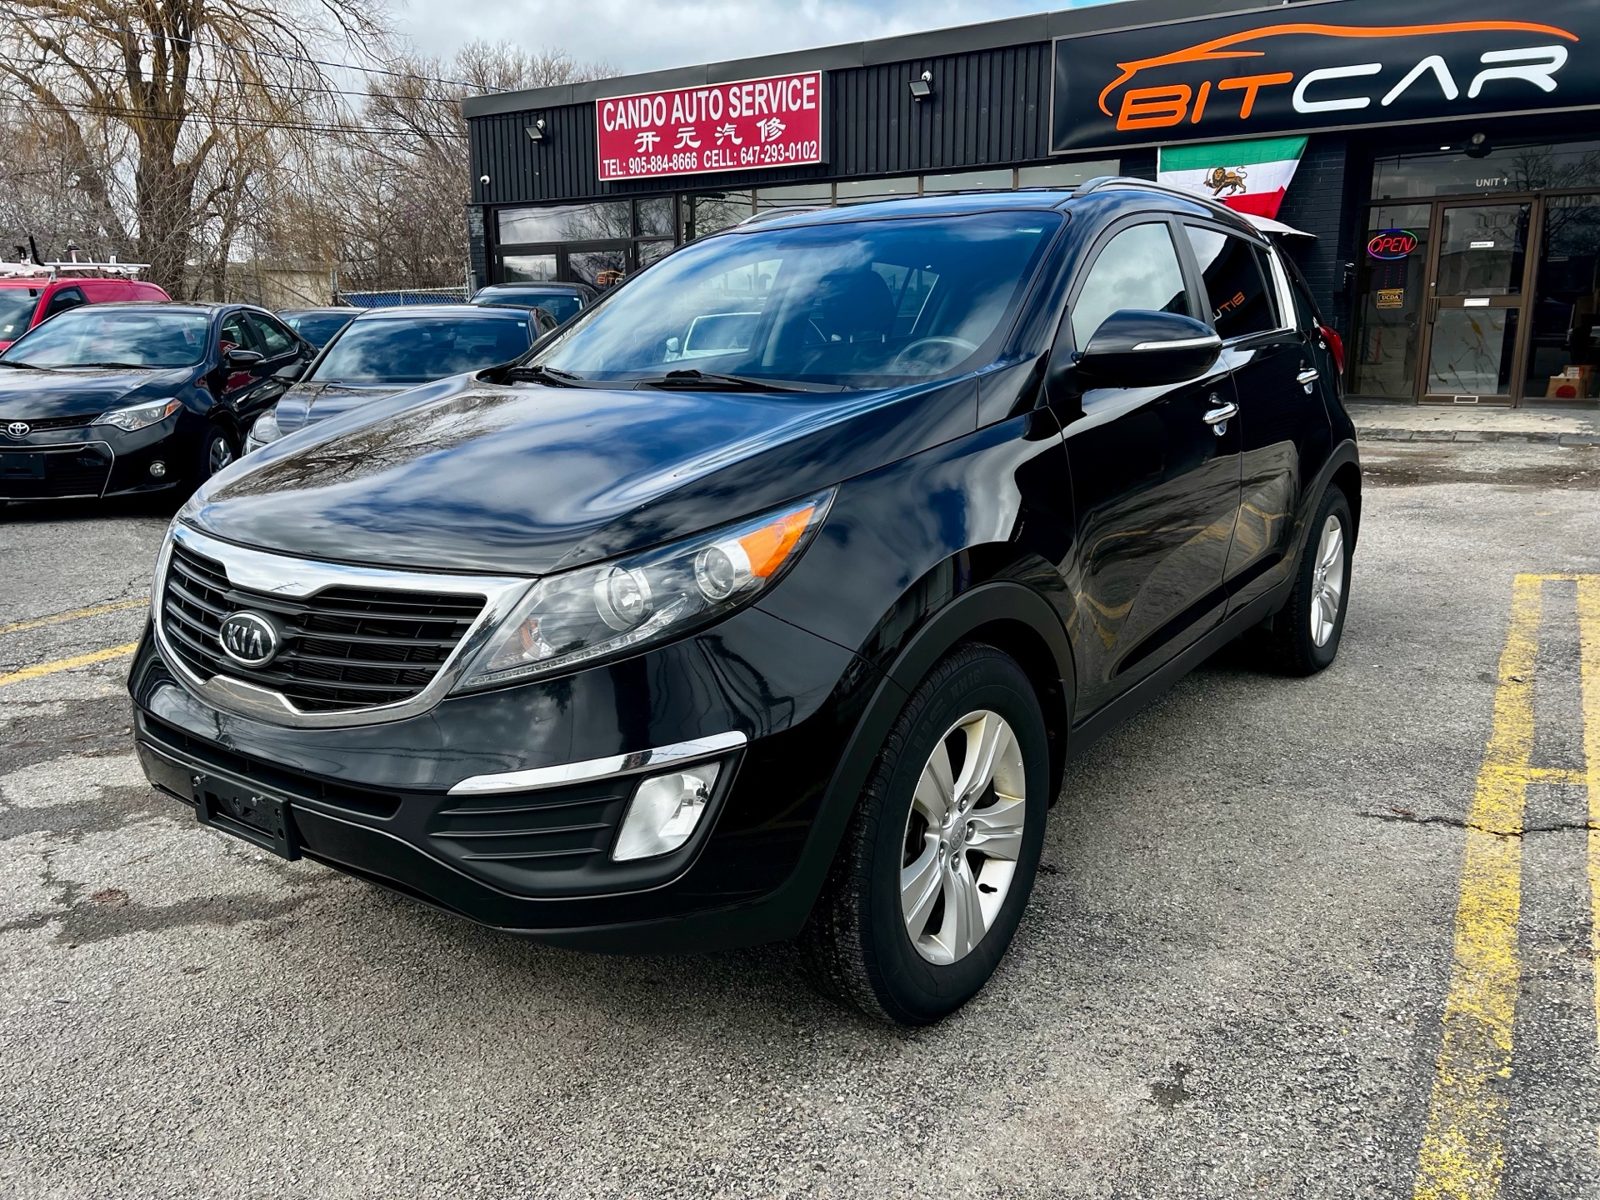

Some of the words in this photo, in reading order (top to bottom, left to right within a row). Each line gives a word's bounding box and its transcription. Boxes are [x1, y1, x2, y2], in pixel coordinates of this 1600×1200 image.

[603, 96, 667, 132] CANDO
[670, 88, 724, 125] AUTO
[728, 77, 816, 119] SERVICE
[1116, 44, 1569, 132] BITCAR
[634, 116, 787, 153] 开元汽修
[603, 159, 626, 176] TEL:
[629, 152, 698, 174] 905-884-8666
[703, 148, 737, 168] CELL:
[740, 140, 817, 165] 647-293-0102
[1475, 177, 1500, 187] UNIT
[1503, 177, 1509, 186] 1
[1370, 236, 1414, 253] OPEN
[227, 622, 264, 657] KIA
